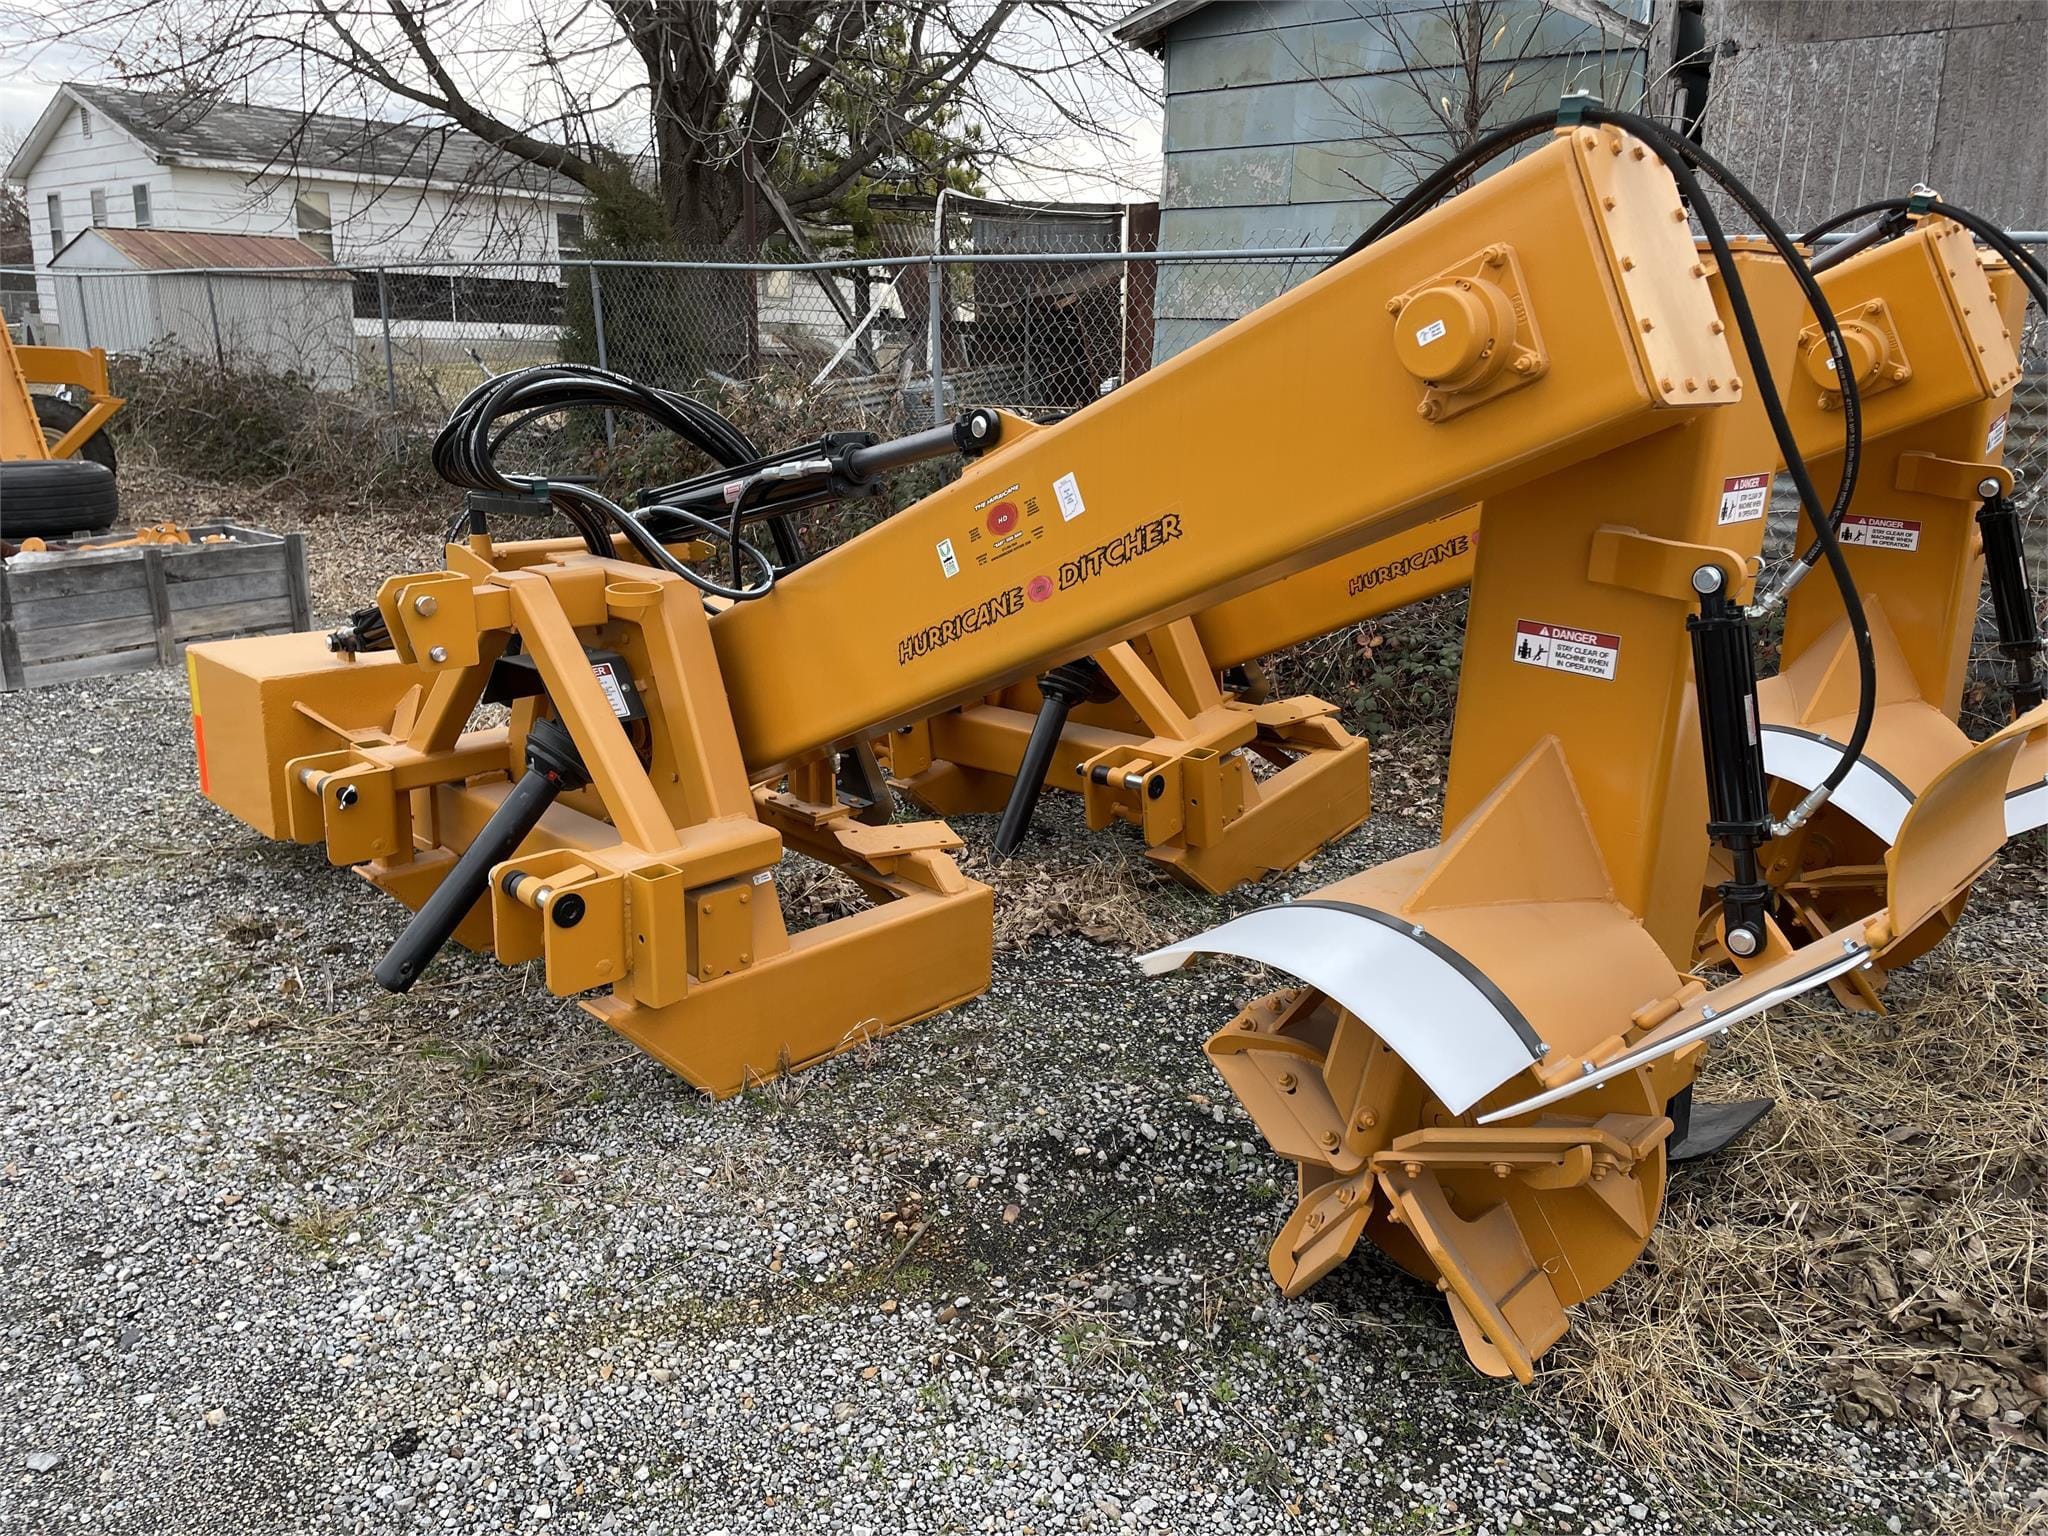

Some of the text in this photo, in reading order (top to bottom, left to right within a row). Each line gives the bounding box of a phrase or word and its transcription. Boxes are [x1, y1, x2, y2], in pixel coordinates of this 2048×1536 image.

[1740, 478, 1760, 489] DANGER
[974, 501, 986, 511] THE
[1868, 518, 1904, 528] DANGER
[1879, 540, 1910, 548] OPERATION
[1348, 534, 1469, 596] HURRICANE
[899, 513, 1183, 665] HURRICANE DITCHER
[1552, 628, 1598, 644] DANGER
[1556, 644, 1610, 658] STAY CLEAR OF
[1556, 652, 1609, 667] MACHINE WHEN
[1564, 662, 1604, 674] OPERATION
